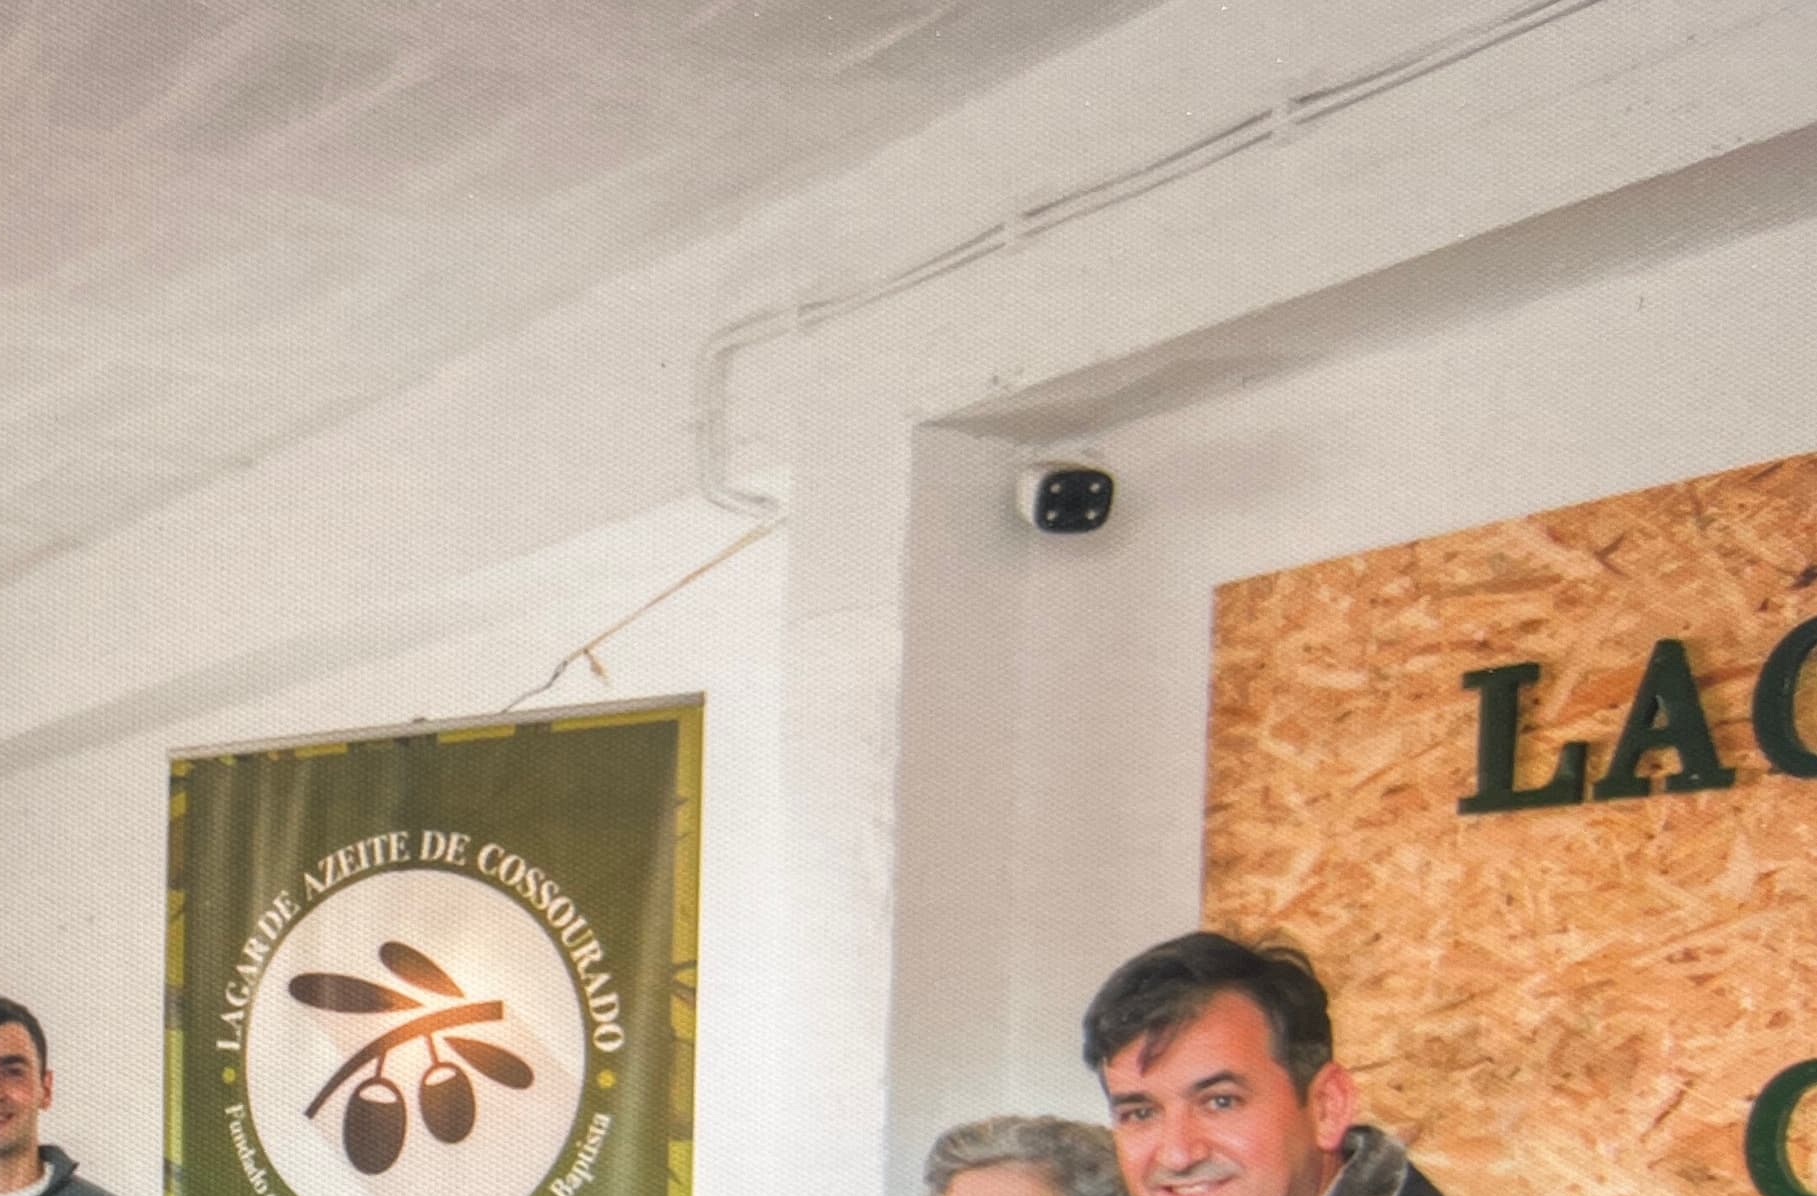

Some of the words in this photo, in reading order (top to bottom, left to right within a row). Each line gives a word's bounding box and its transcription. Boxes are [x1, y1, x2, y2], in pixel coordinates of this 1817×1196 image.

[216, 936, 271, 1050] LAGAR
[257, 890, 301, 941] DE
[303, 831, 411, 901] AZEITE
[419, 830, 471, 866] DE
[477, 843, 625, 1052] COSSOURADO
[225, 1103, 268, 1195] Fundado
